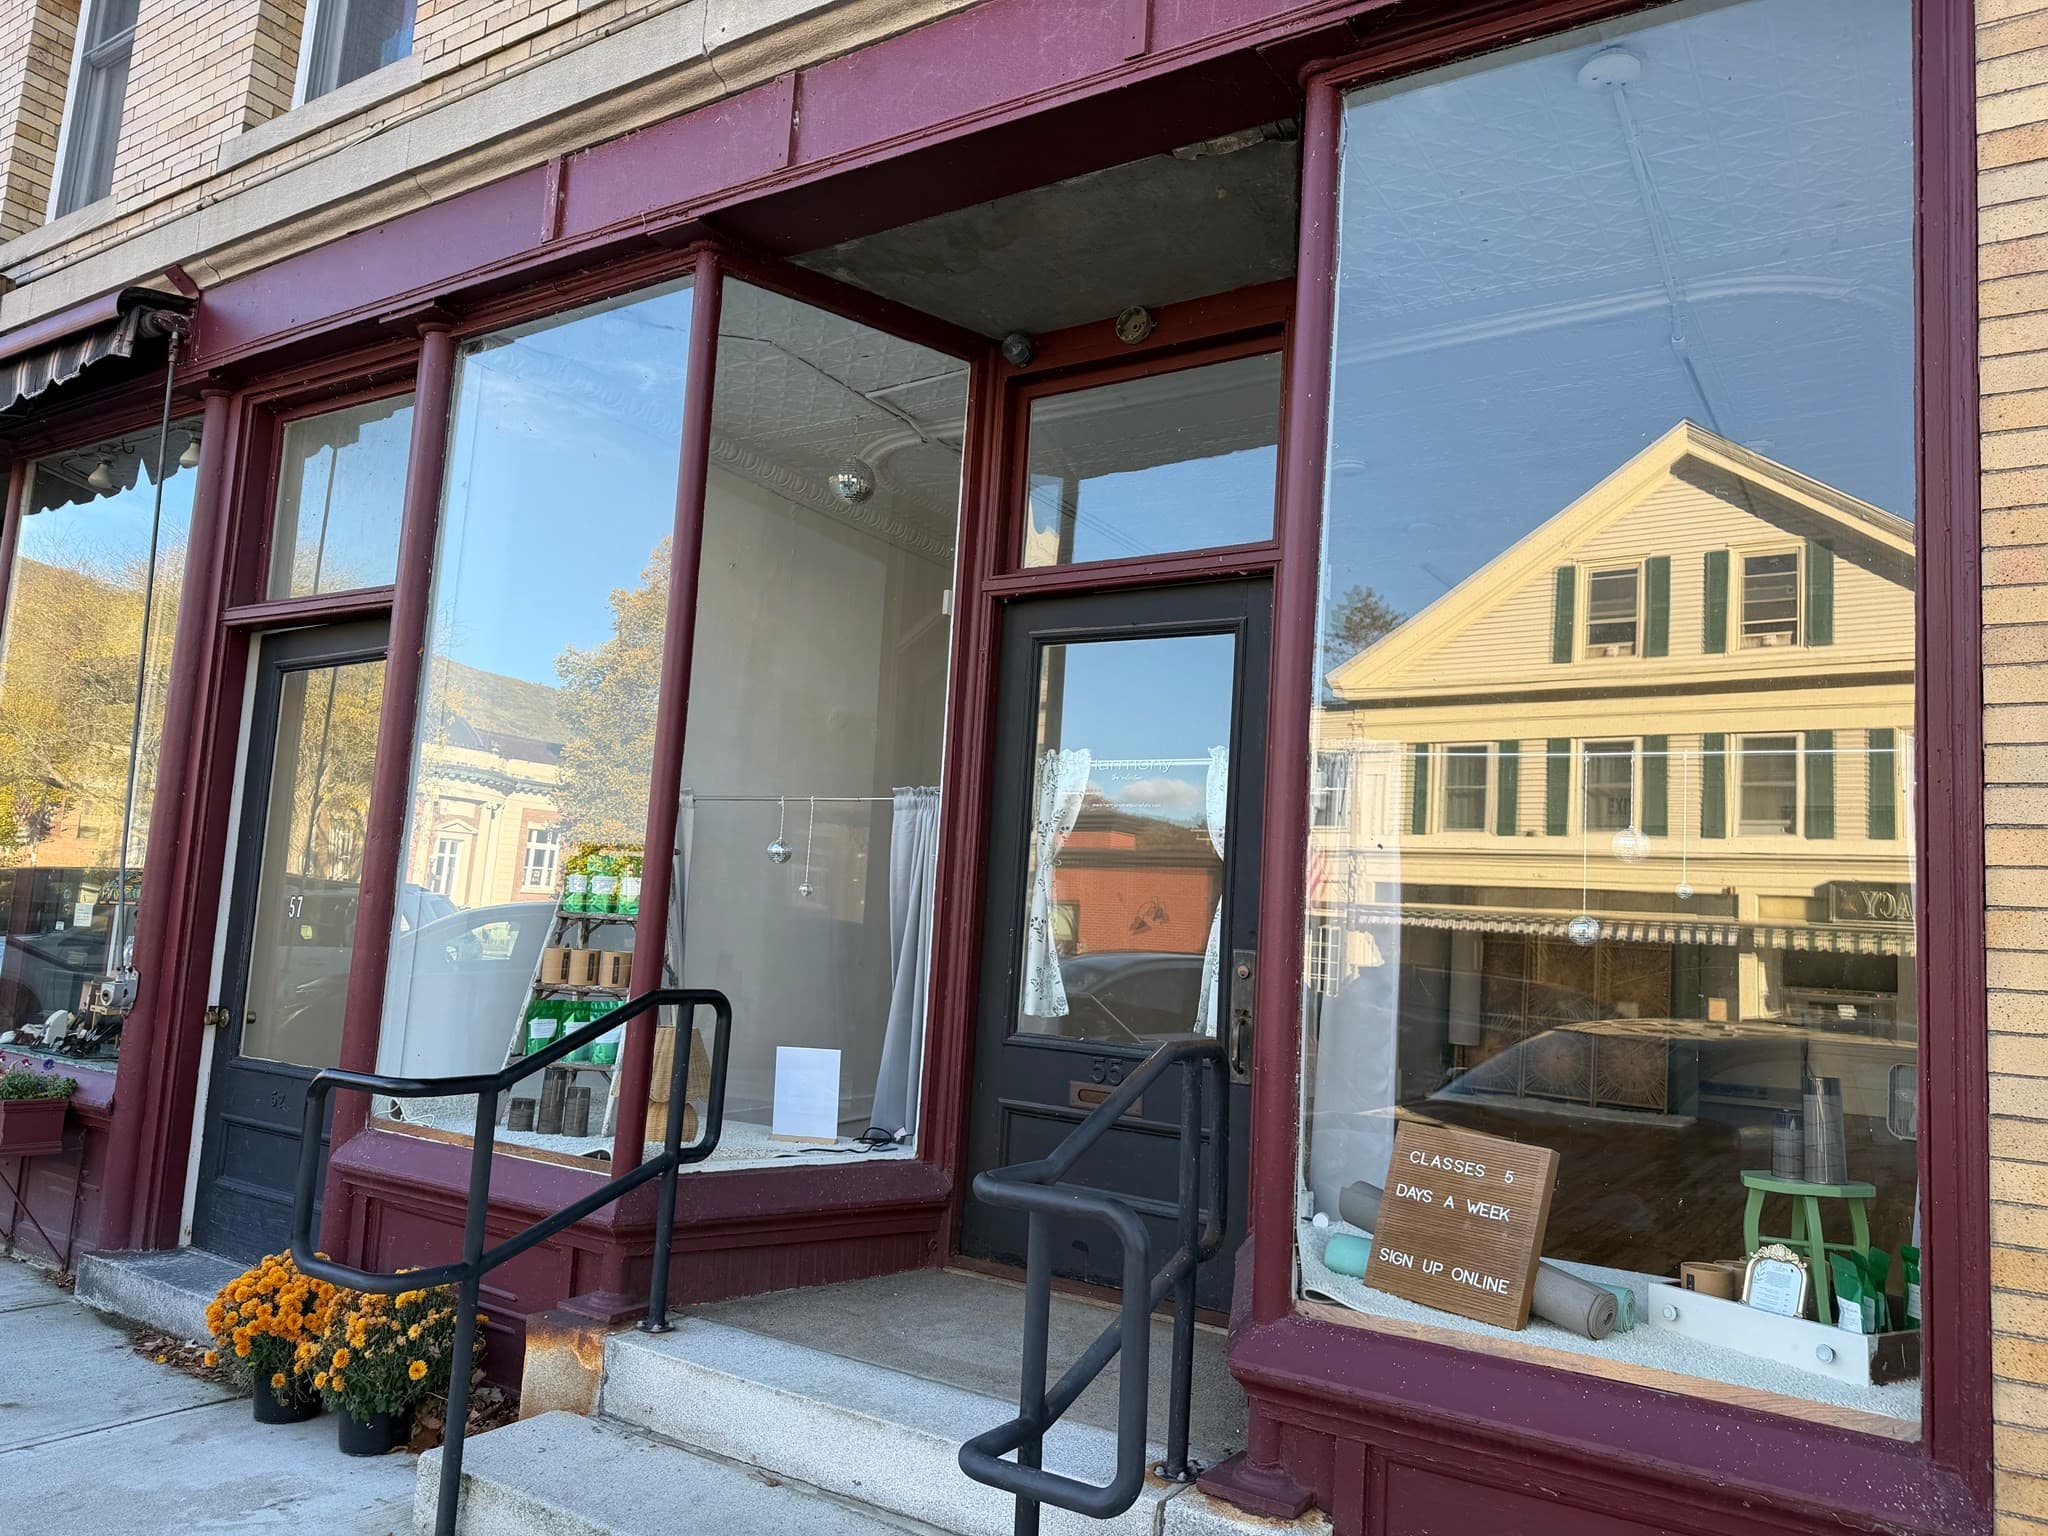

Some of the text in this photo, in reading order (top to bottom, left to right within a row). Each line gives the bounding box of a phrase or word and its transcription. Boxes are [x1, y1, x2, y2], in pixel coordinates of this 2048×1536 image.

[288, 896, 304, 918] 57
[1089, 1056, 1123, 1085] 55
[1409, 1150, 1515, 1184] CLASSES 5
[1396, 1183, 1510, 1222] DAYS A WEEK
[1379, 1247, 1510, 1295] SIGN UP ONLINE
